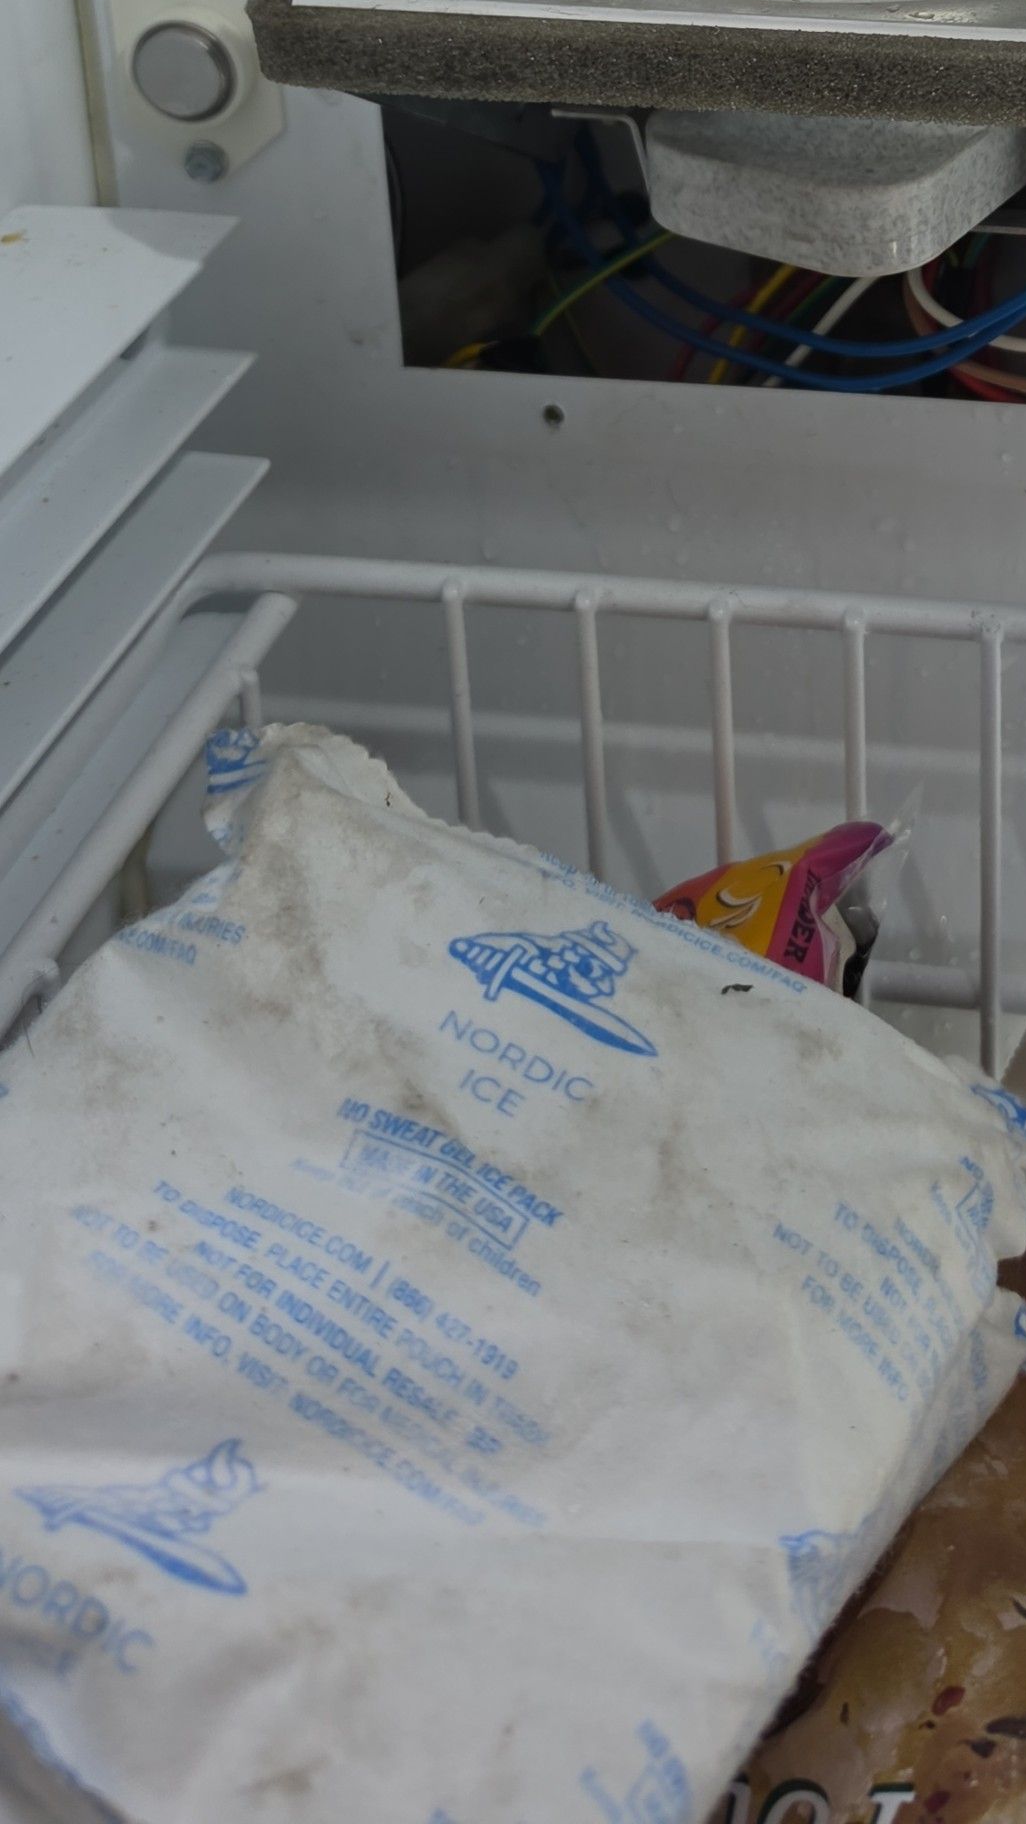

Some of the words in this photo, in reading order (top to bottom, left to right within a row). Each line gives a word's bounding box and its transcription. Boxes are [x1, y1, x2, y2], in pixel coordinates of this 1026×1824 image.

[439, 1009, 594, 1102] NORDIC
[459, 1068, 526, 1118] ICE
[368, 1108, 446, 1150] SWEAT
[438, 1138, 476, 1170] GEL
[476, 1161, 516, 1191] ICE
[506, 1183, 564, 1227] PACK
[435, 1171, 478, 1204] THE
[473, 1196, 515, 1233] USA
[153, 1179, 182, 1204] TO
[265, 1242, 331, 1290] PLACE
[325, 1279, 398, 1339] ENTIRE
[225, 1187, 374, 1275] NORDICICE.COM
[467, 1236, 542, 1297] children
[217, 1291, 252, 1323] ON
[248, 1313, 309, 1362] BODY
[235, 1262, 278, 1300] FOR
[275, 1289, 382, 1378] INDIVIDUAL
